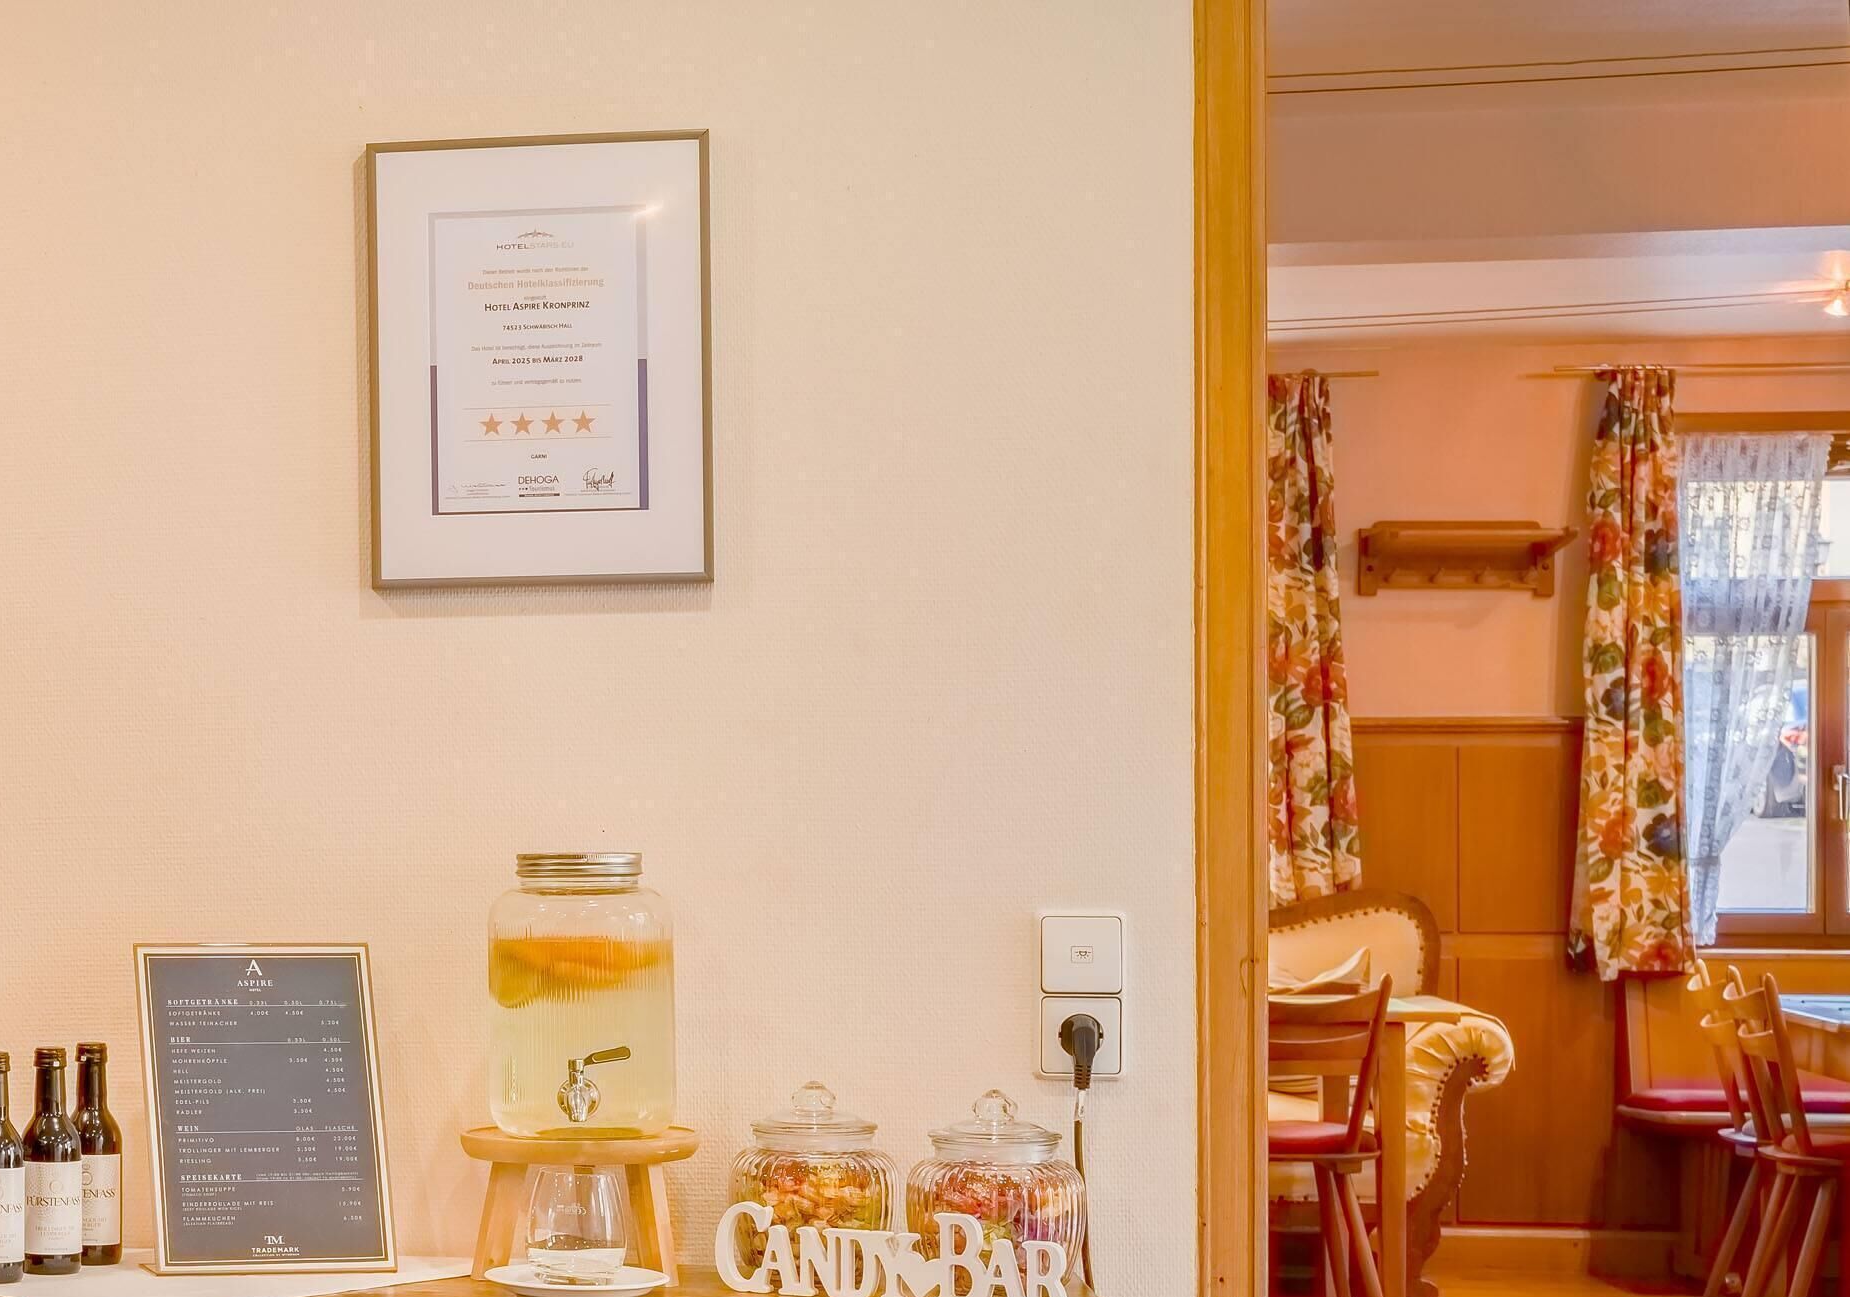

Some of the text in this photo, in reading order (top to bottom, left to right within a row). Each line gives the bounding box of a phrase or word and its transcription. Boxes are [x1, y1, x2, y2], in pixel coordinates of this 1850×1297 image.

[467, 278, 605, 290] Deutschen Hotelklassifizierung
[511, 357, 531, 365] 2025
[518, 475, 560, 485] DEHOGA
[237, 979, 274, 987] ASPIRE
[180, 1173, 242, 1181] SPEISEKARTE
[251, 1246, 299, 1254] TRADEMARK
